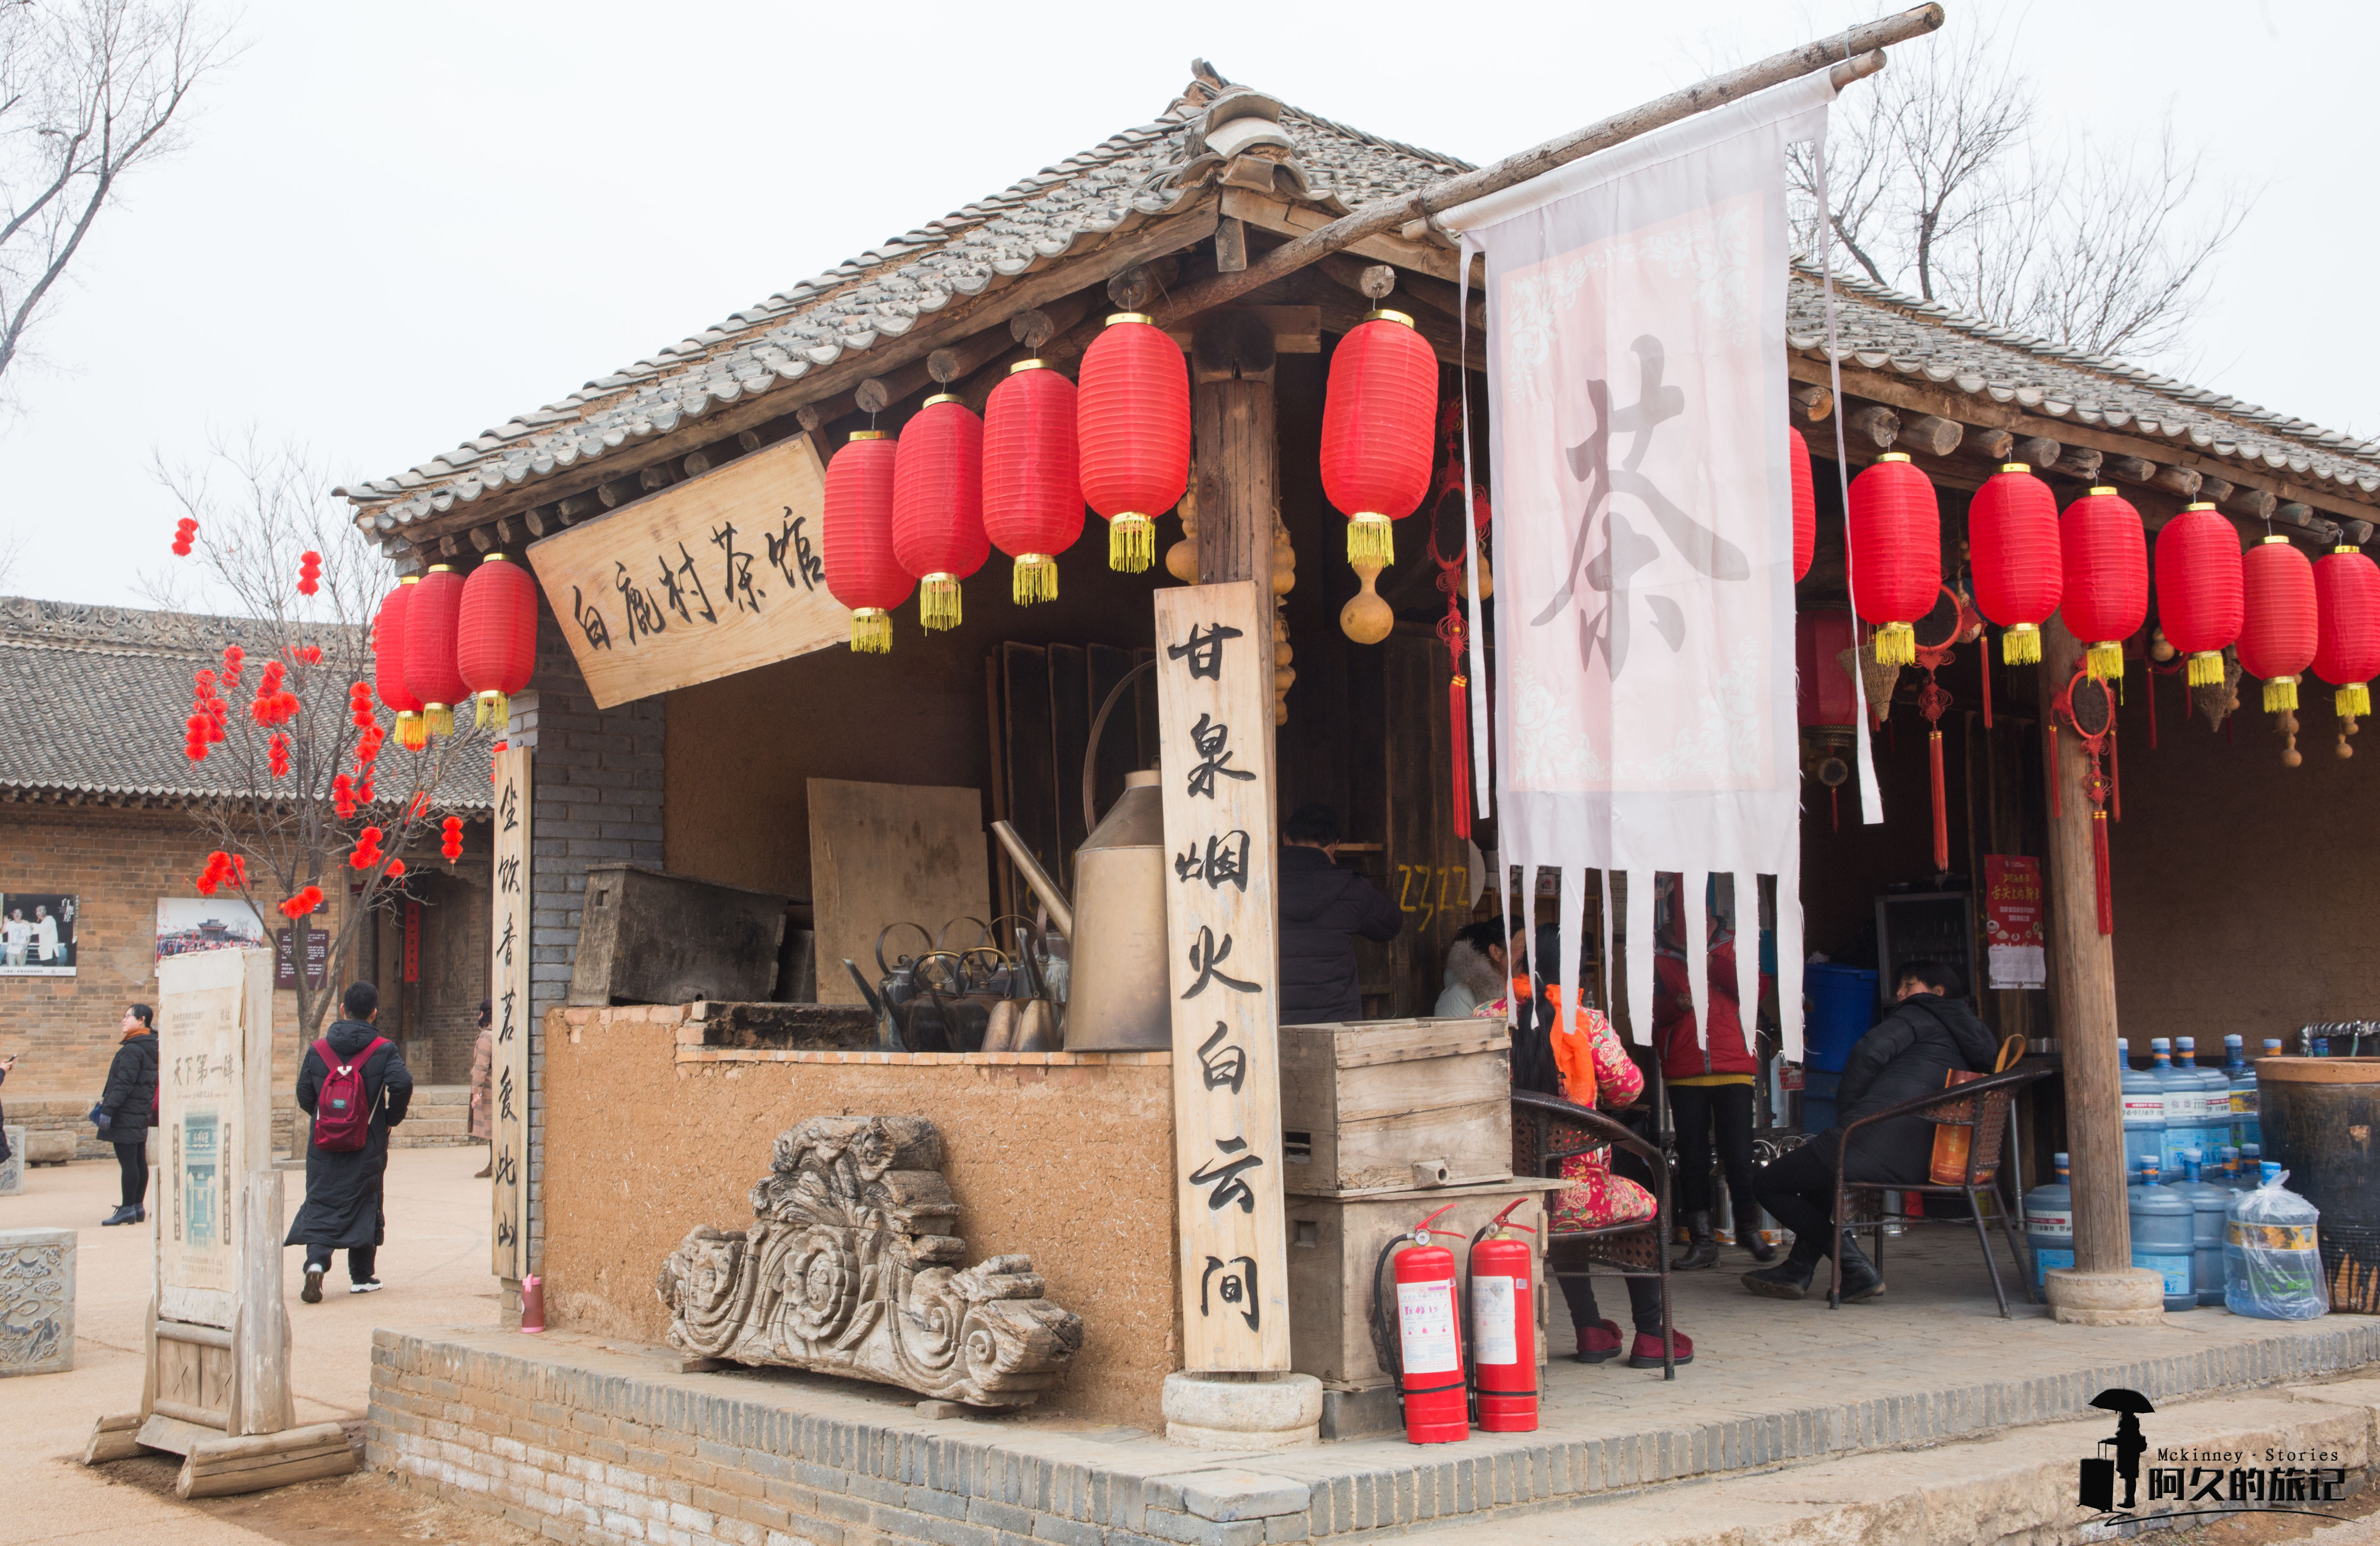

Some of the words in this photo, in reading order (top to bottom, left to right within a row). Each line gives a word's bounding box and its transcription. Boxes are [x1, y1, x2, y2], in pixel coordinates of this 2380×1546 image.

[573, 506, 826, 651] 白鹿村茶馆
[1530, 334, 1749, 683] 茶
[495, 777, 521, 1247] 坐饮香茗爱此山
[1168, 623, 1264, 1333] 甘泉烟火白云间
